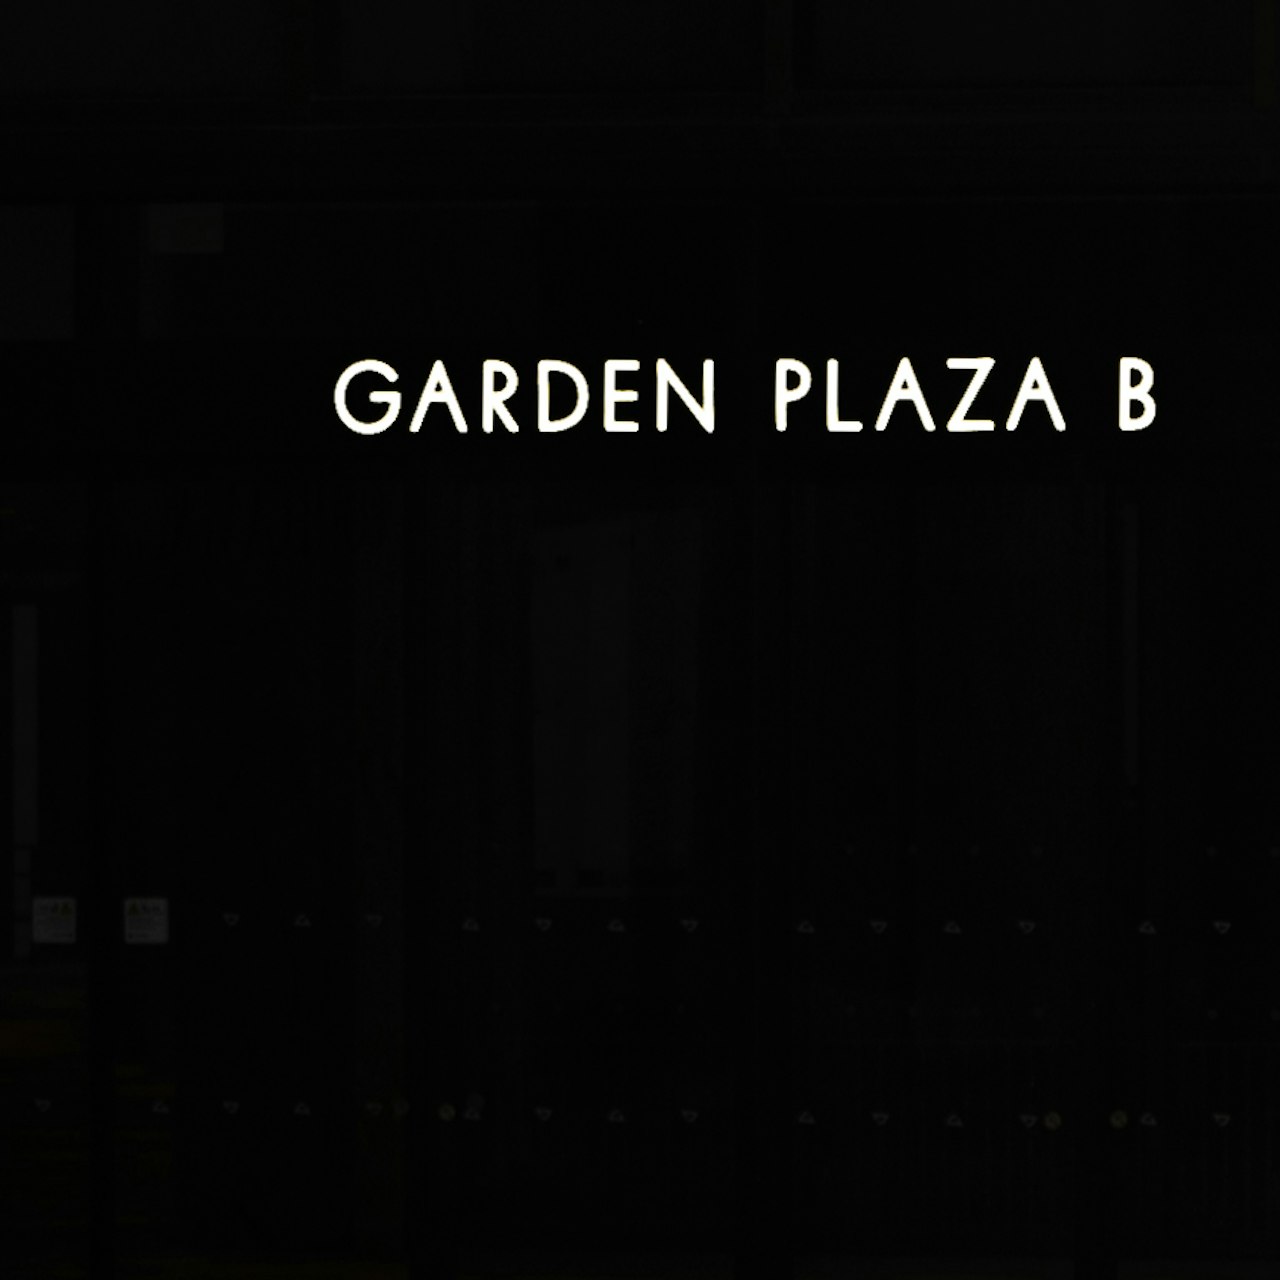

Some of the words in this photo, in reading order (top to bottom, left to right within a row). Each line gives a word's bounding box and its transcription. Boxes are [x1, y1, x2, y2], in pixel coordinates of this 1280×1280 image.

[333, 356, 715, 436] GARDEN
[774, 356, 1067, 433] PLAZA
[1118, 356, 1157, 433] B
